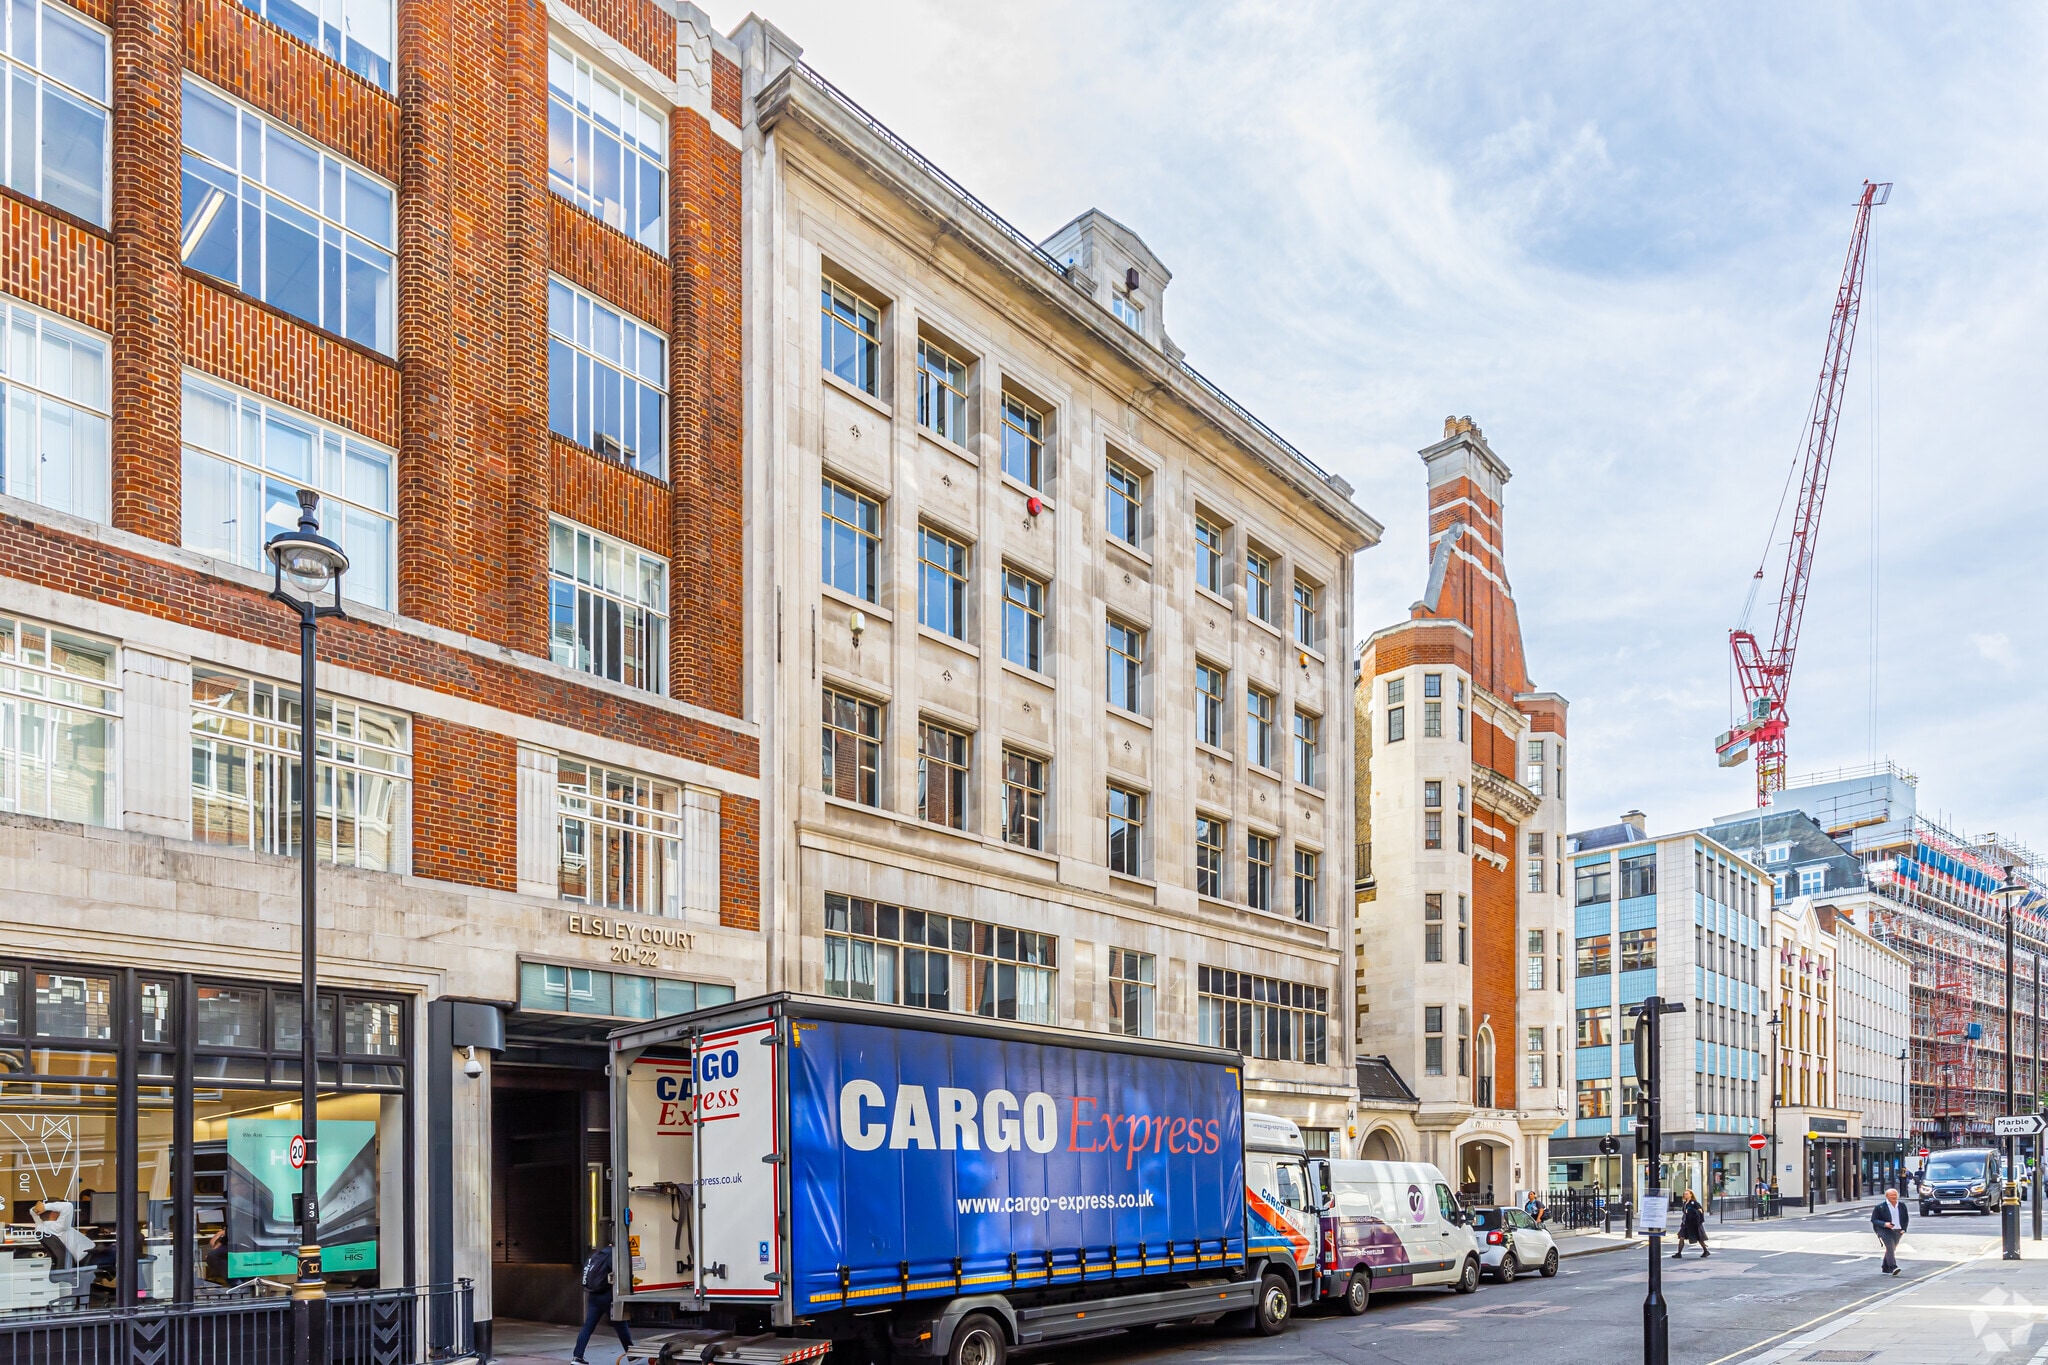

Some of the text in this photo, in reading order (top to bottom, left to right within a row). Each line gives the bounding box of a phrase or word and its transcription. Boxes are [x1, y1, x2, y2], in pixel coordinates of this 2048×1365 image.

[569, 915, 696, 949] ELSLEY COURT
[611, 945, 659, 967] 20-22
[692, 1049, 739, 1084] GO
[840, 1079, 1221, 1171] CARGO Express
[1347, 1109, 1354, 1120] 14
[292, 1145, 304, 1159] 20
[19, 1173, 30, 1193] our
[957, 1189, 1154, 1216] www.cargo-express.co.uk
[1261, 1188, 1285, 1215] CARGO
[3, 1229, 52, 1241] Things
[344, 1253, 364, 1261] HKS
